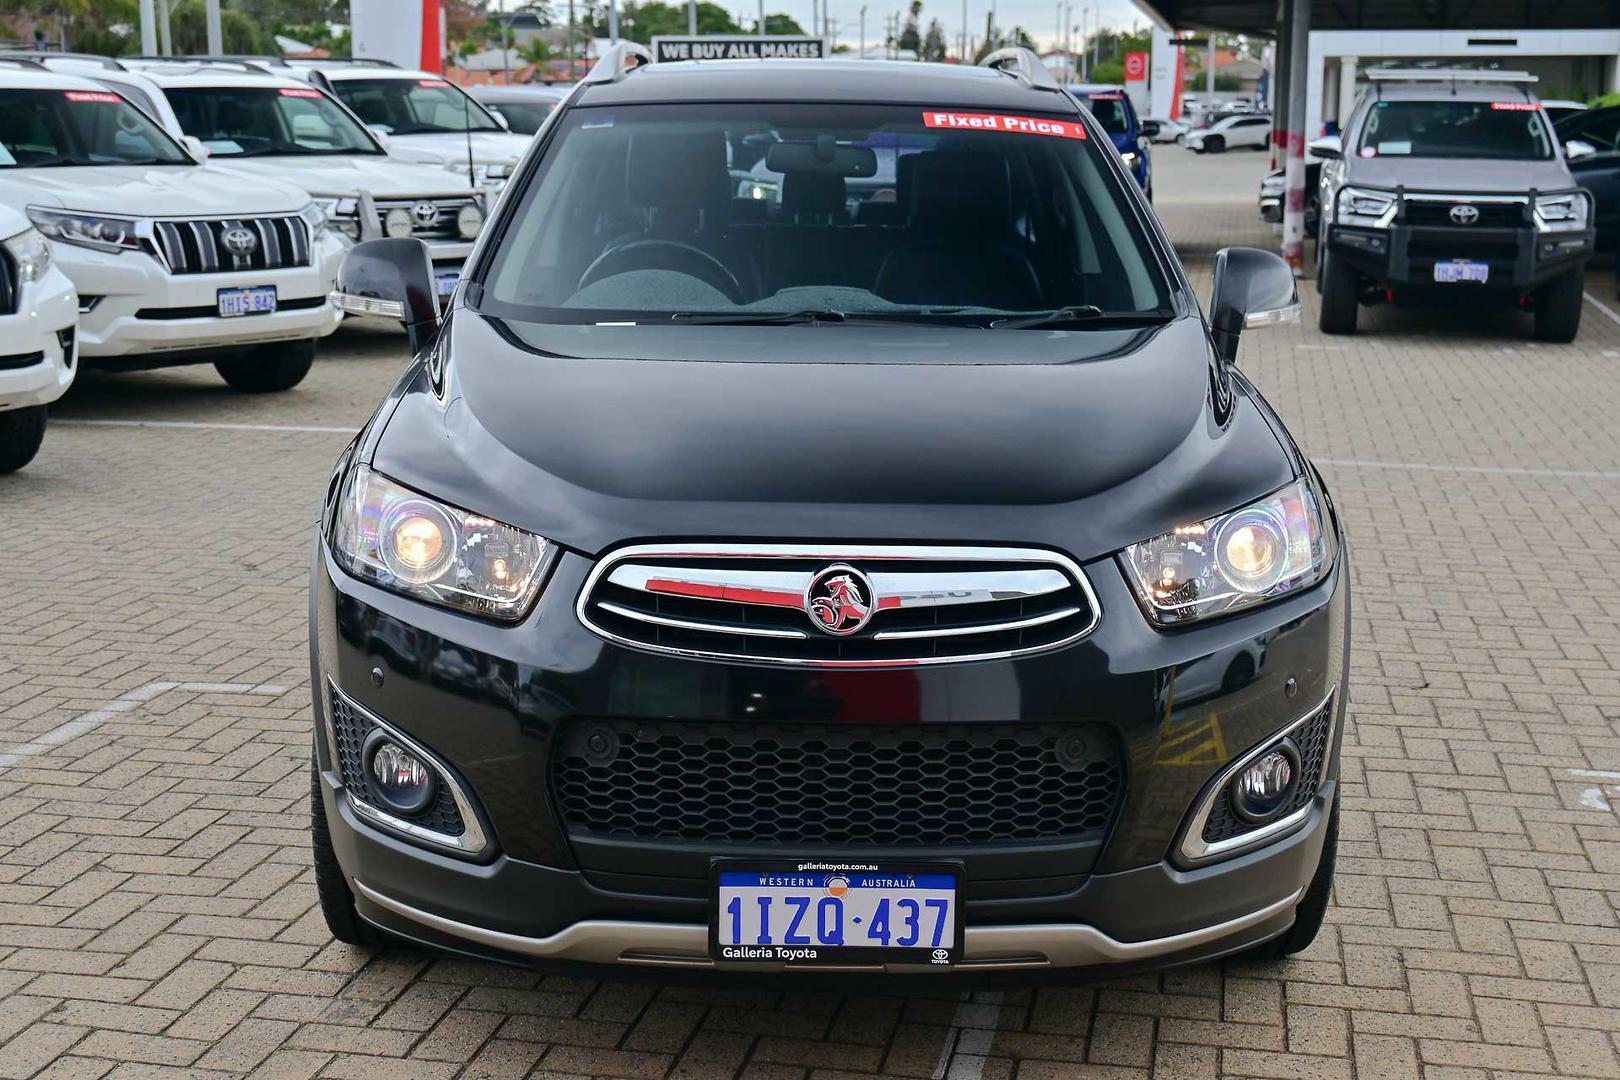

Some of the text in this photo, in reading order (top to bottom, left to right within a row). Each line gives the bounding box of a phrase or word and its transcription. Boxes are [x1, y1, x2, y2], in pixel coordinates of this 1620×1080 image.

[662, 43, 819, 59] WE BUY ALL MAKES
[933, 113, 997, 129] Fixed
[1003, 117, 1065, 135] Price
[797, 862, 879, 872] galleriatoyota.com.au
[759, 877, 916, 888] WESTERN AUSTRALIA
[722, 947, 818, 961] Galleria Toyota
